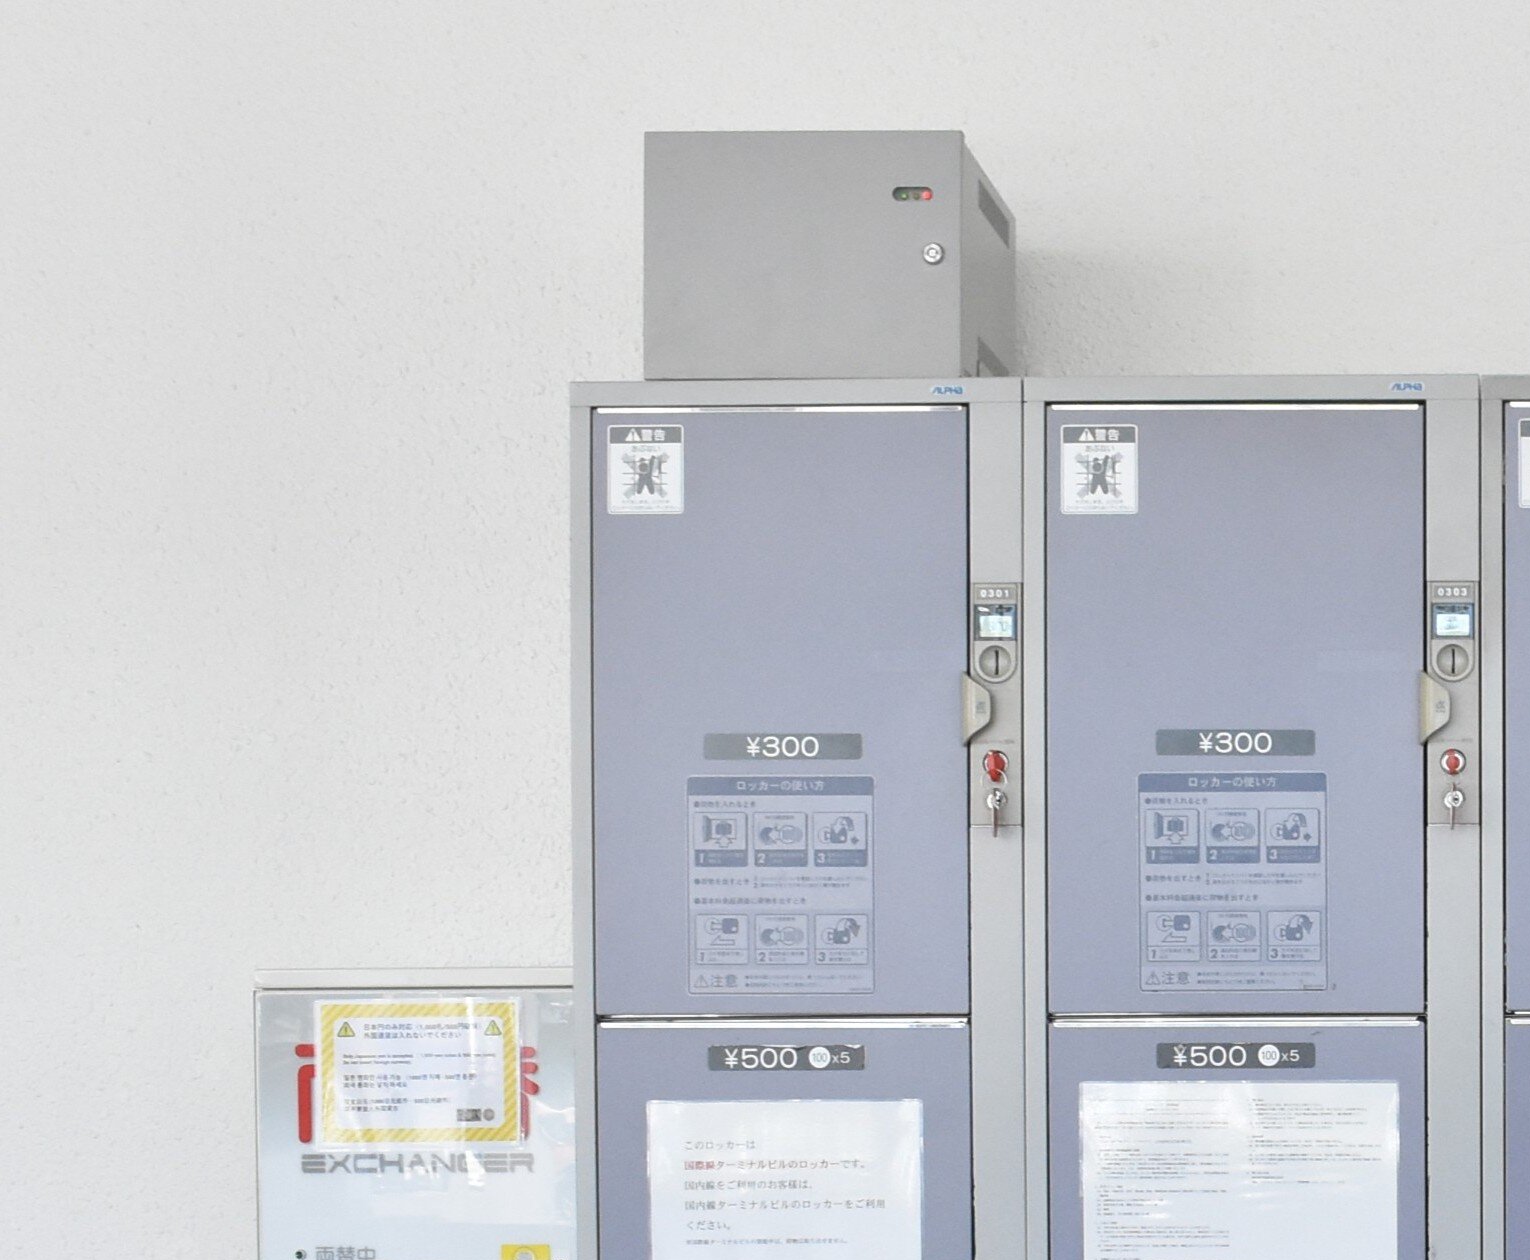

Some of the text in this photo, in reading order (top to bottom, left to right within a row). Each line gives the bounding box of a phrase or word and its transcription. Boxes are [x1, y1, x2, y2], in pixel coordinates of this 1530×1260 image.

[980, 589, 1010, 598] 0301
[1437, 587, 1468, 597] 0303
[747, 736, 820, 757] ¥300
[1198, 732, 1273, 753] ¥300
[736, 780, 824, 791] ロッカーの使い方
[1188, 776, 1278, 788] ロッカーの使い方
[724, 1047, 798, 1069] ¥500
[1173, 1045, 1247, 1067] ¥500
[684, 1140, 756, 1150] このロッカーは
[684, 1160, 867, 1171] 国際線ターミナルビルのロッカーです。
[684, 1199, 886, 1210] 国内線ターミナルビルのロッカーをご利用
[686, 1220, 732, 1231] ください。
